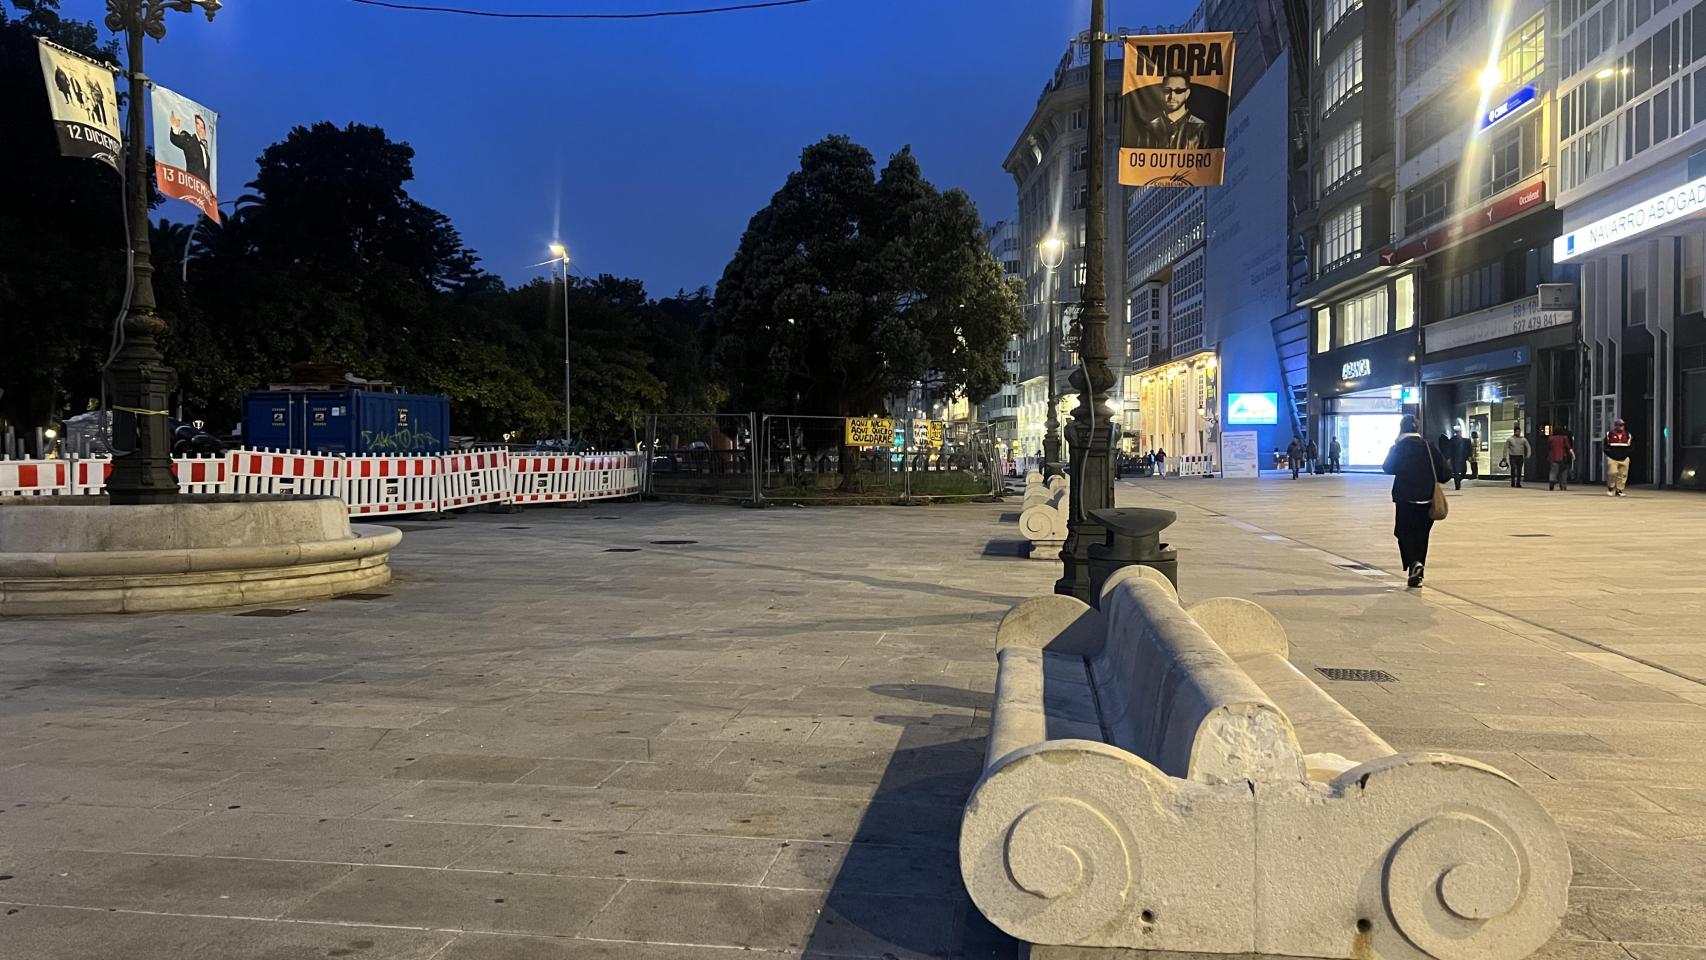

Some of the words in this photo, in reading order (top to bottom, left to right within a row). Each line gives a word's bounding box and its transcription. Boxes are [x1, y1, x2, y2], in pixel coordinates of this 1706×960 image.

[1136, 42, 1224, 76] MORA
[66, 124, 83, 140] 12
[1129, 152, 1146, 167] 09
[1150, 153, 1212, 168] OUTUBRO
[162, 167, 174, 182] 13
[1518, 189, 1540, 206] Occident
[1590, 209, 1645, 243] NAVARRO
[1513, 320, 1526, 335] 627
[1527, 315, 1542, 331] 479
[1543, 312, 1557, 327] 841
[852, 434, 893, 444] QUEDARME
